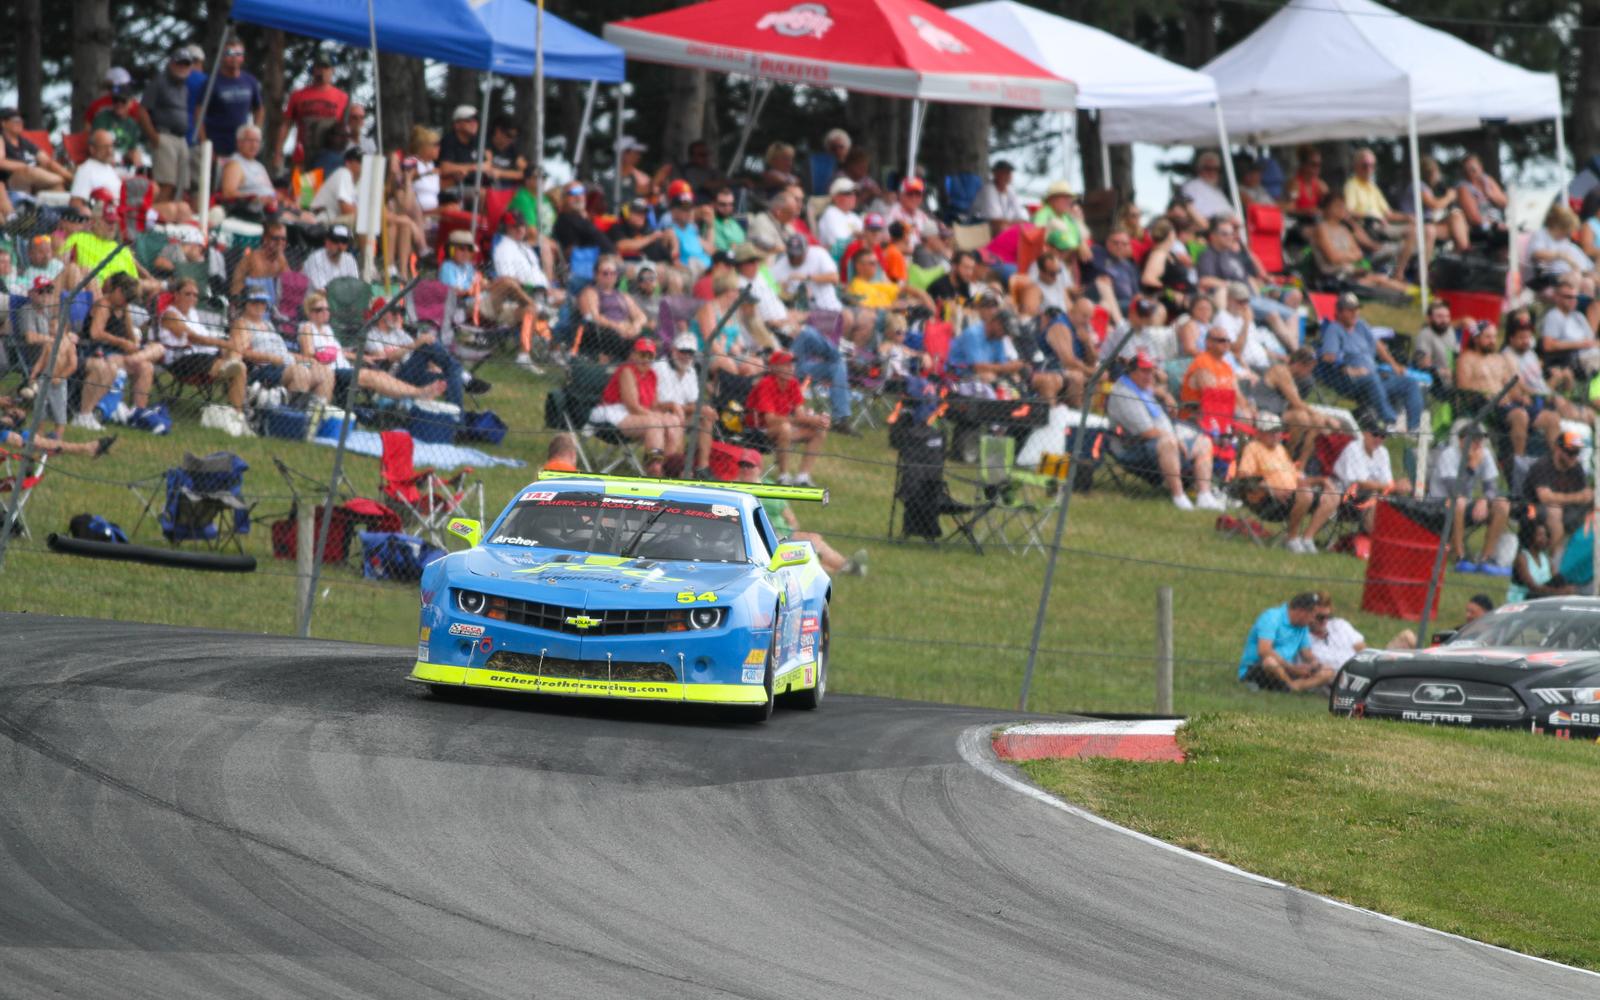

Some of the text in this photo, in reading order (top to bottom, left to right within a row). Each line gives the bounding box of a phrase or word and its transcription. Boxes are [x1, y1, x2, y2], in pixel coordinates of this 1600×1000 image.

[760, 57, 831, 80] BUCKEYES
[525, 491, 553, 500] TA2
[537, 499, 598, 507] AMERICA'S
[600, 501, 634, 509] ROAD
[636, 504, 680, 514] RACNG
[683, 509, 719, 519] SERIES
[493, 535, 538, 546] Archer
[676, 591, 718, 603] 54
[490, 674, 668, 693] archerbrothersracing.com
[1402, 711, 1472, 722] MUSTANG
